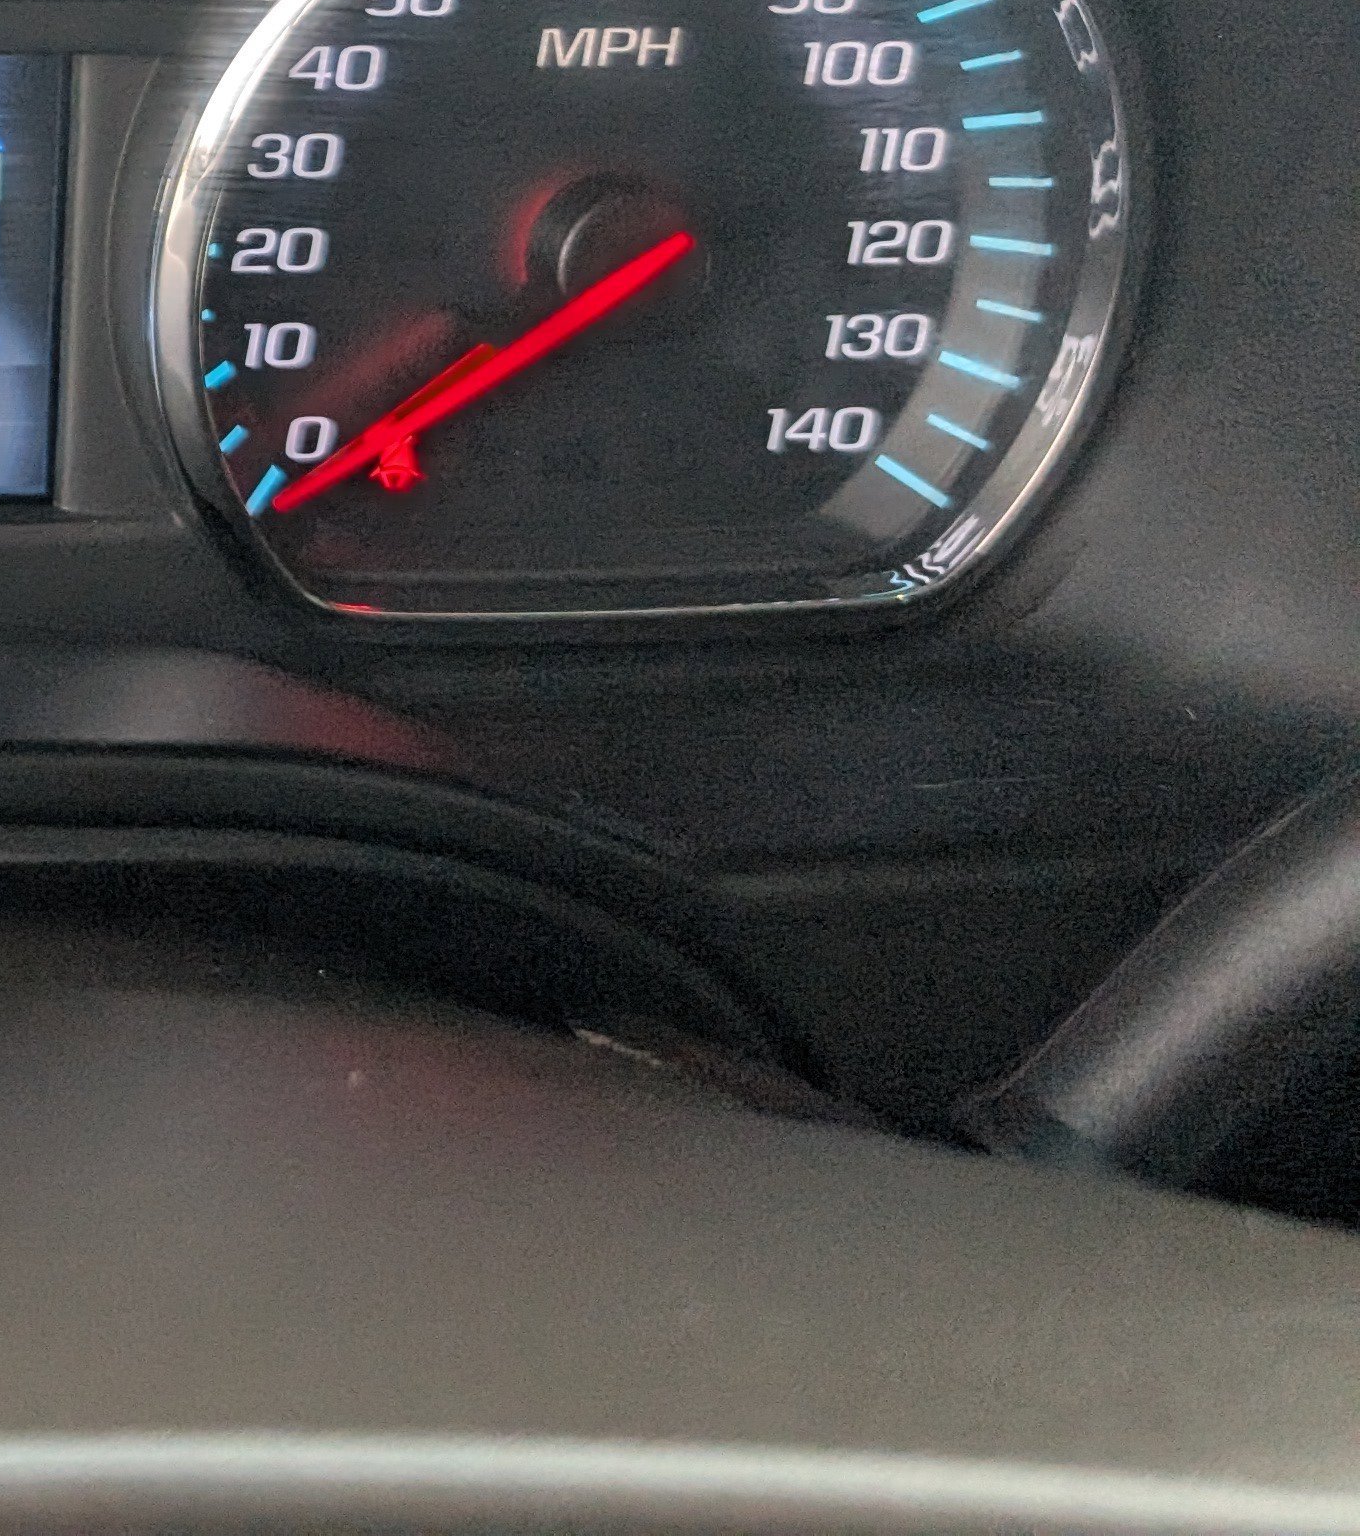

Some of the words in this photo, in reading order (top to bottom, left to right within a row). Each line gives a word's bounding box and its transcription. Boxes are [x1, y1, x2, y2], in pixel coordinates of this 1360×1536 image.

[288, 45, 383, 91] 40
[536, 27, 681, 68] MPH
[802, 41, 914, 87] 100
[247, 132, 341, 179] 30
[859, 127, 946, 173] 110
[231, 227, 328, 273] 20
[846, 219, 952, 265] 120
[243, 322, 315, 369] 10
[825, 313, 930, 360] 130
[285, 416, 337, 462] 0
[766, 406, 877, 453] 140
